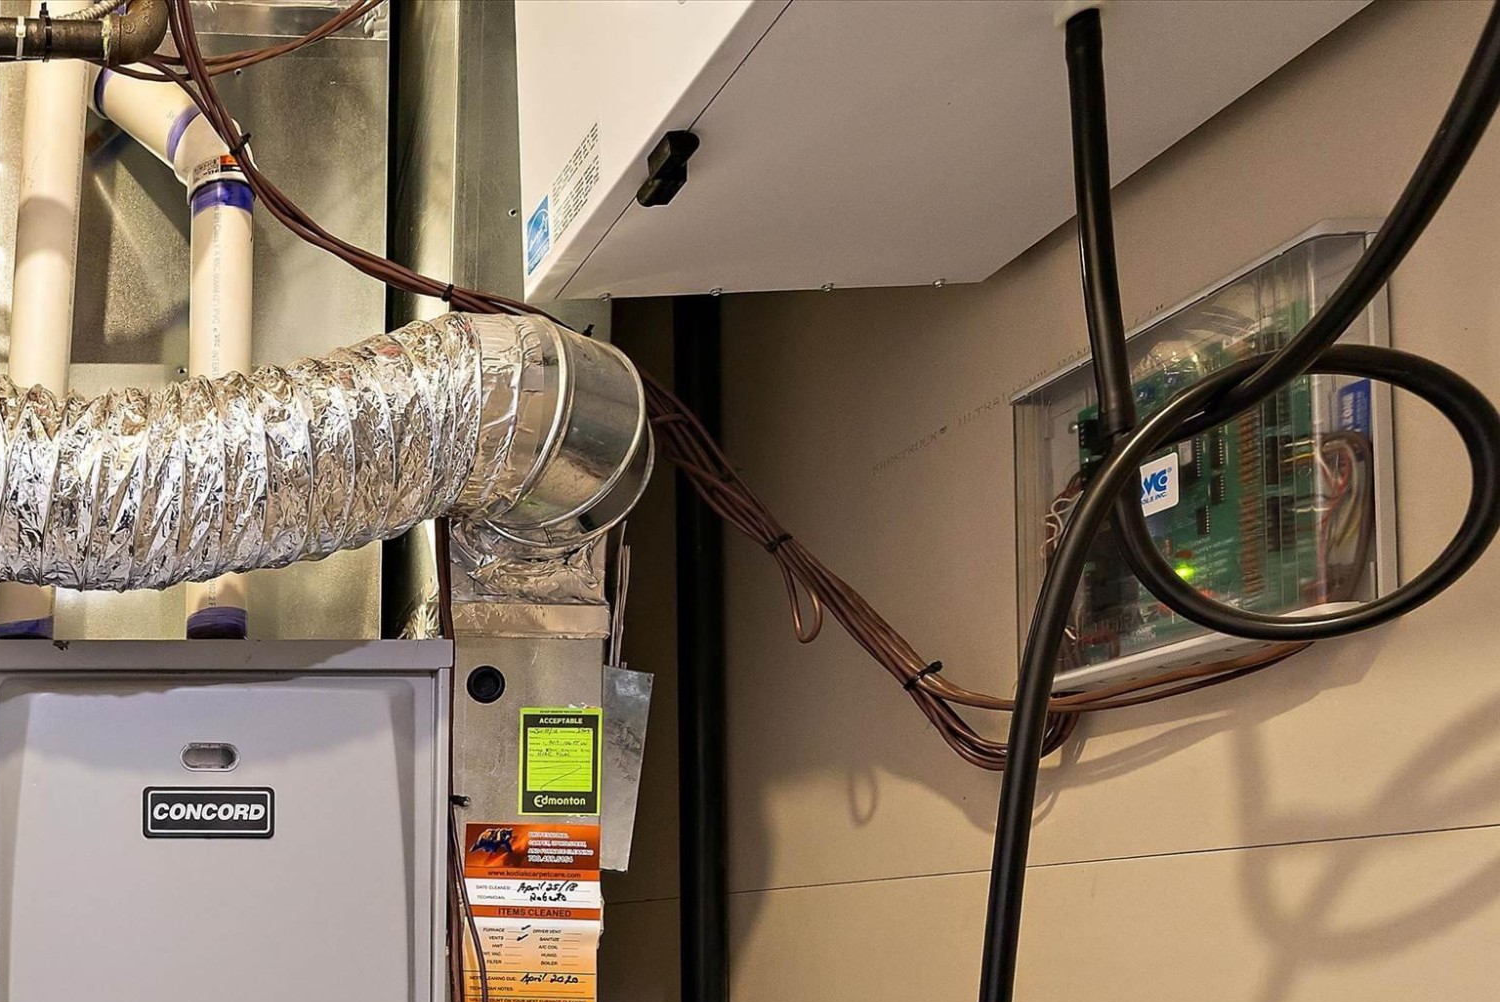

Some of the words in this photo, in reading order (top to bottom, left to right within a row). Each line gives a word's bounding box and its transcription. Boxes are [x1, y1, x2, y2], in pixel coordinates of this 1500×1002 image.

[534, 795, 586, 807] Edmonton
[153, 803, 265, 821] CONCORD
[516, 881, 546, 893] April
[498, 908, 526, 916] ITEMS
[528, 909, 572, 918] CLEANED
[520, 972, 547, 984] April
